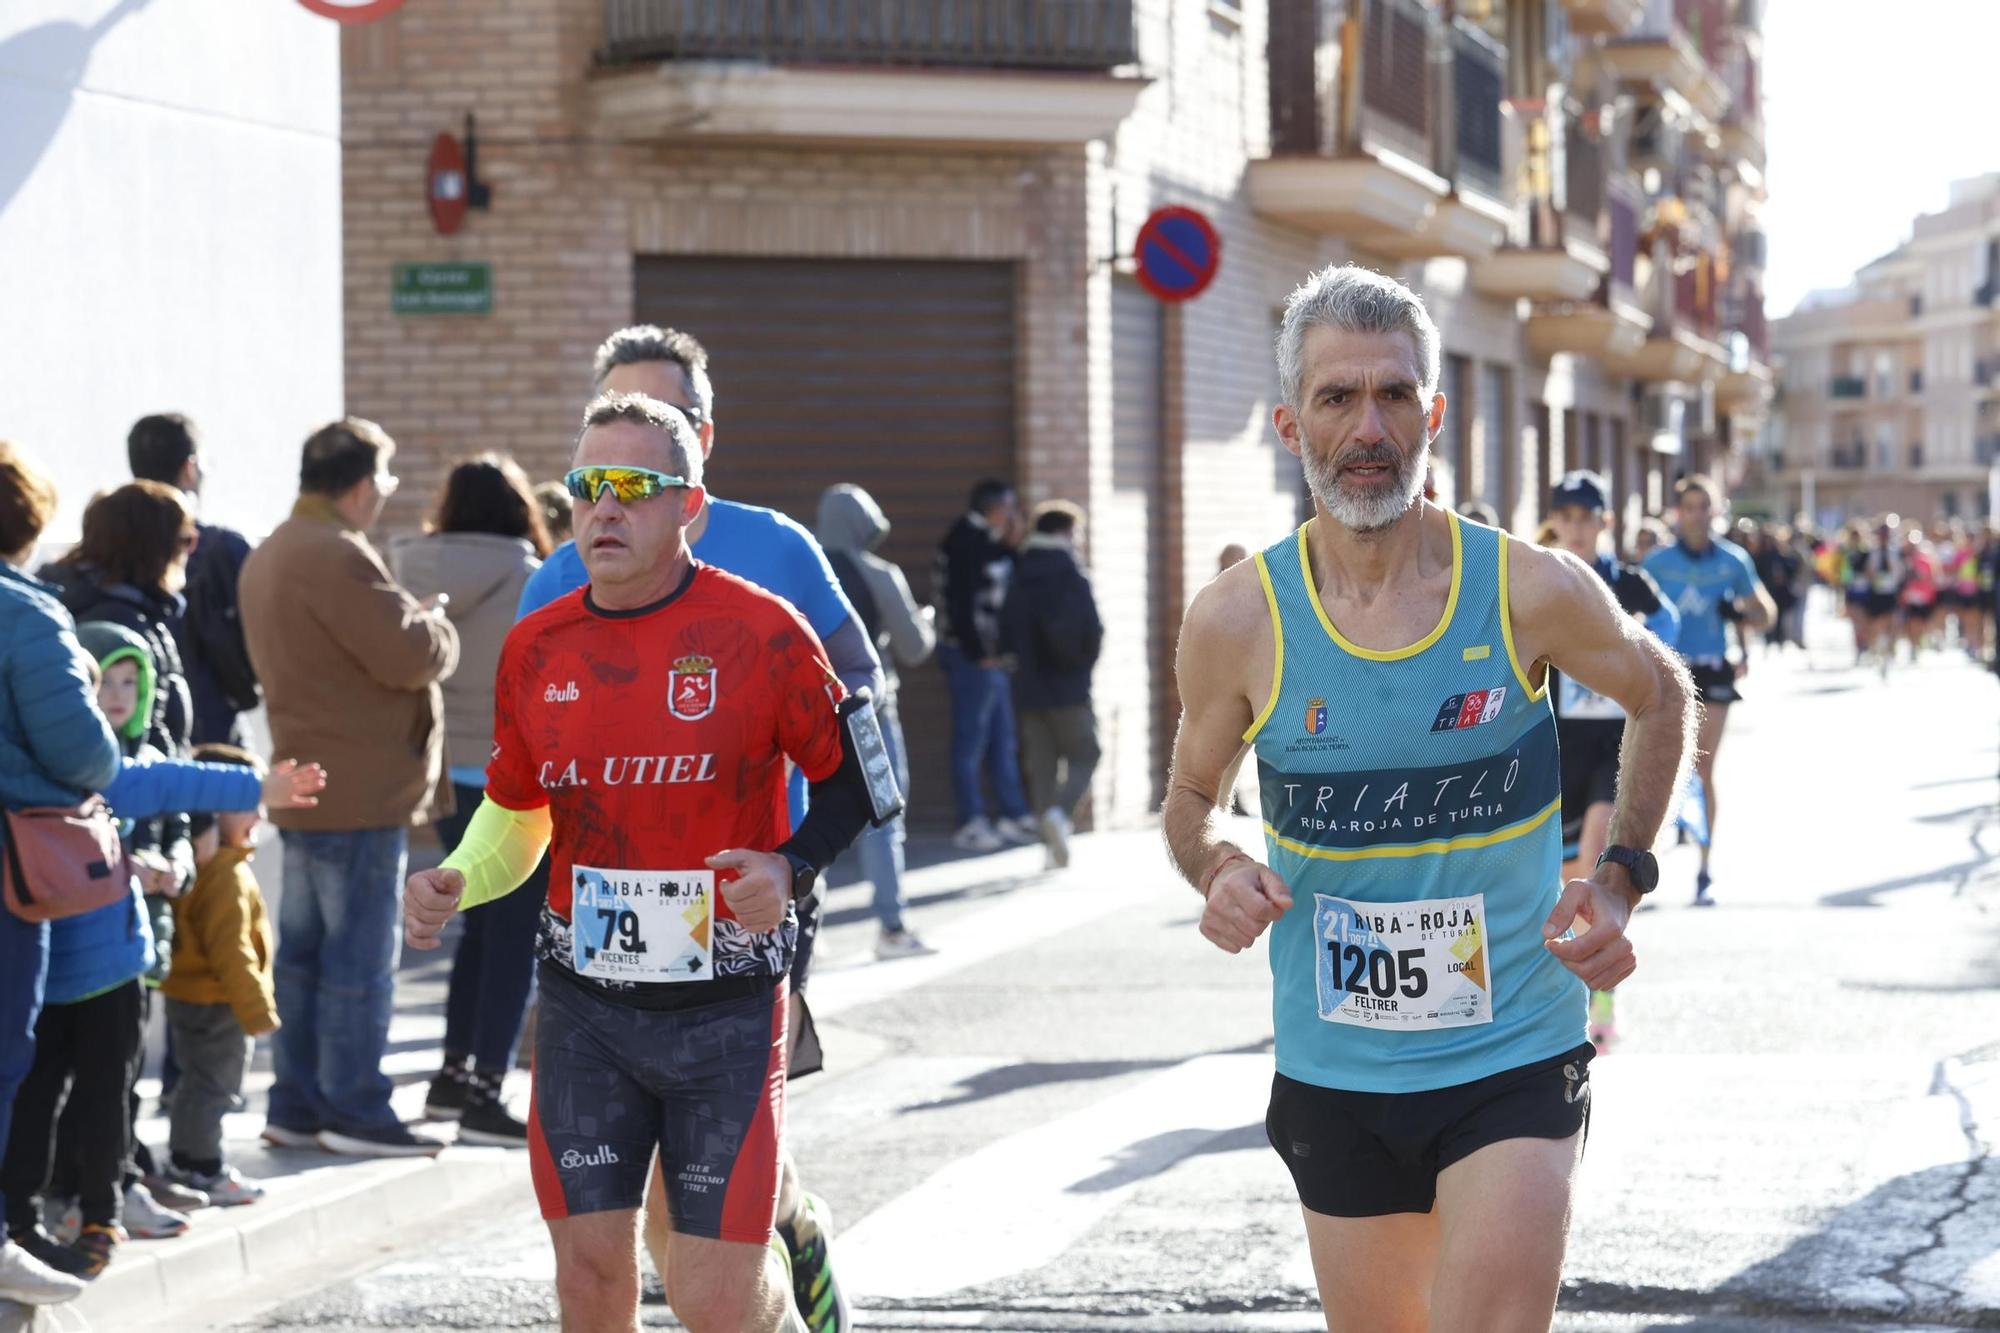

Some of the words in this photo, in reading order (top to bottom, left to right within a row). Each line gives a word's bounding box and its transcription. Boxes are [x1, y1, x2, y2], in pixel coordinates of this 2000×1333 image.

[557, 681, 580, 701] ulb
[602, 753, 717, 786] UTIEL
[1284, 749, 1520, 813] TRIATLÓ
[1301, 816, 1402, 832] RIBA-ROJA
[1414, 813, 1438, 828] DE
[1449, 803, 1504, 823] TURIA
[579, 882, 598, 908] 21
[597, 908, 640, 953] 79
[1323, 910, 1350, 943] 21
[1421, 932, 1435, 941] DE
[600, 952, 640, 965] VICENTES
[1327, 941, 1429, 999] 1205
[1447, 961, 1477, 974] LOCAL
[1355, 996, 1399, 1012] FELTRER
[586, 1144, 620, 1166] ulb
